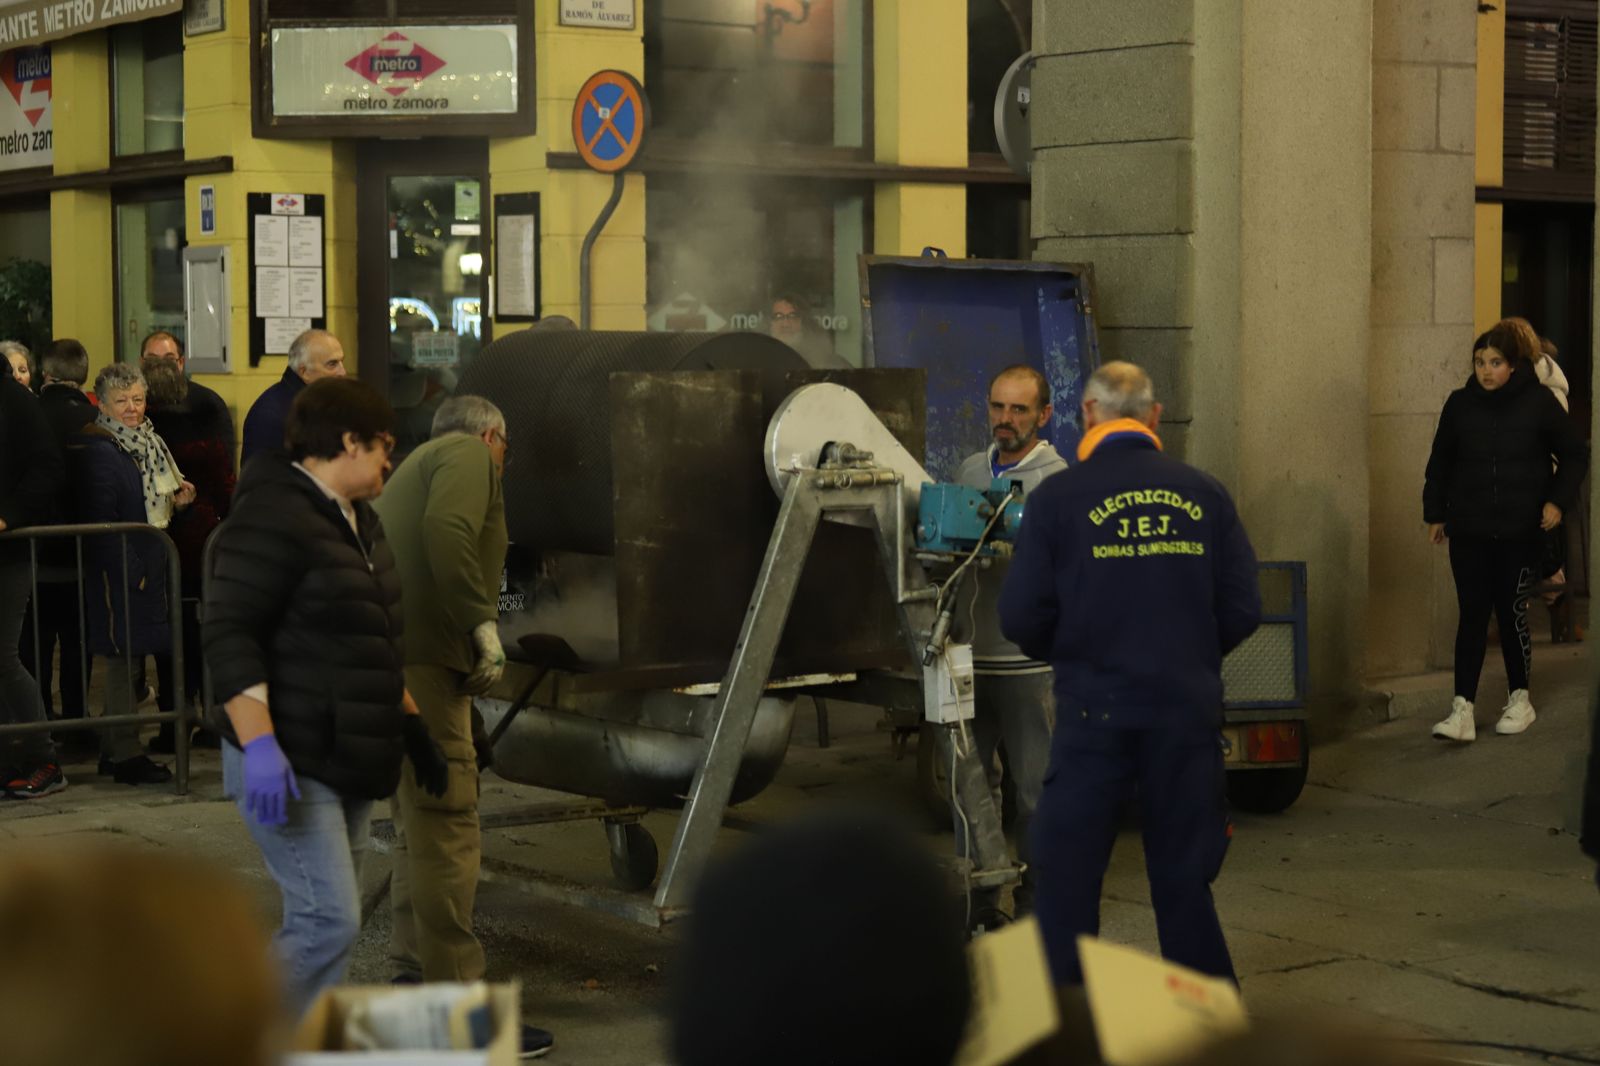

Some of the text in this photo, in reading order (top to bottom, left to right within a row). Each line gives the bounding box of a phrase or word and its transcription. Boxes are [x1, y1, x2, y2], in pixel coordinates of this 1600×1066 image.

[592, 1, 606, 9] DE
[43, 0, 95, 34] METRO
[100, 0, 176, 19] ZAM
[17, 53, 50, 79] metro
[374, 57, 417, 71] metro
[343, 97, 449, 110] metro zamora
[1088, 489, 1203, 526] ELECTRICIDAD
[1117, 515, 1178, 538] J.E.J.
[1092, 544, 1135, 559] BOMBAS
